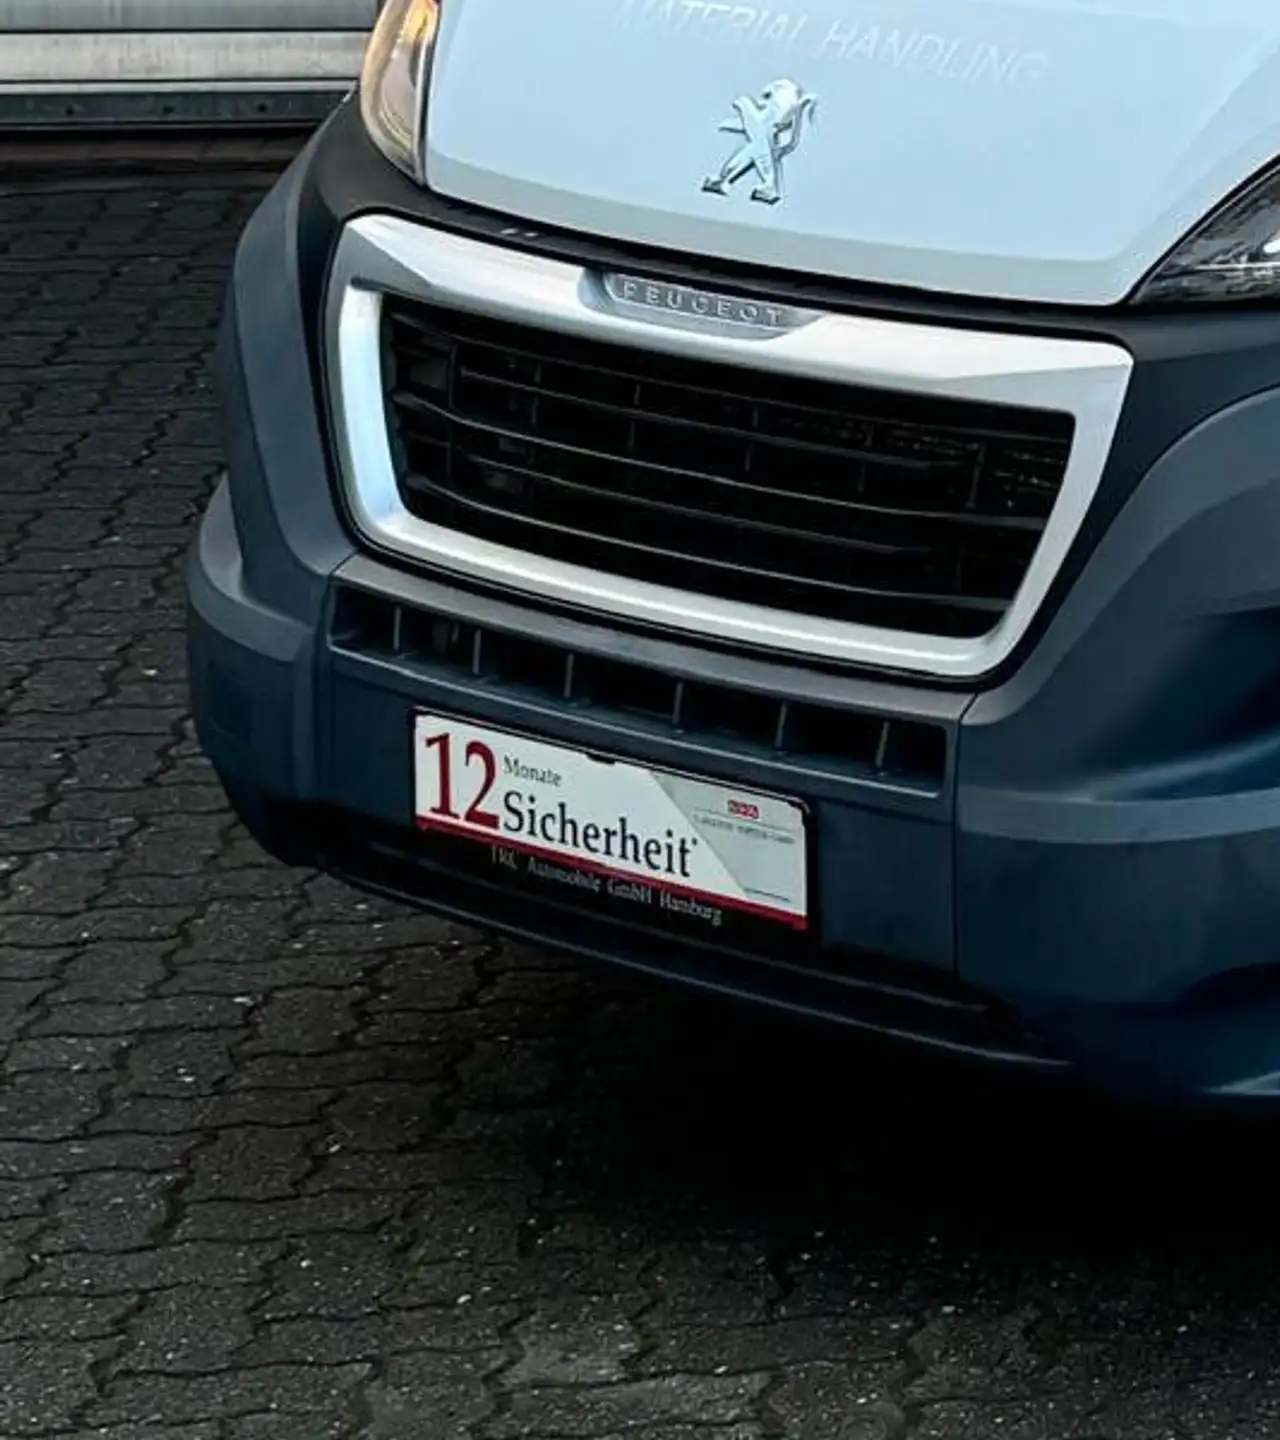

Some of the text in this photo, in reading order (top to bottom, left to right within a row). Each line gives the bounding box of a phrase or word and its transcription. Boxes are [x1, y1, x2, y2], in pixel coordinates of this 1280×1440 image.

[819, 18, 1050, 86] HANDLING
[622, 279, 783, 326] PEUGEOT
[425, 732, 500, 830] 12
[503, 753, 562, 787] Monate
